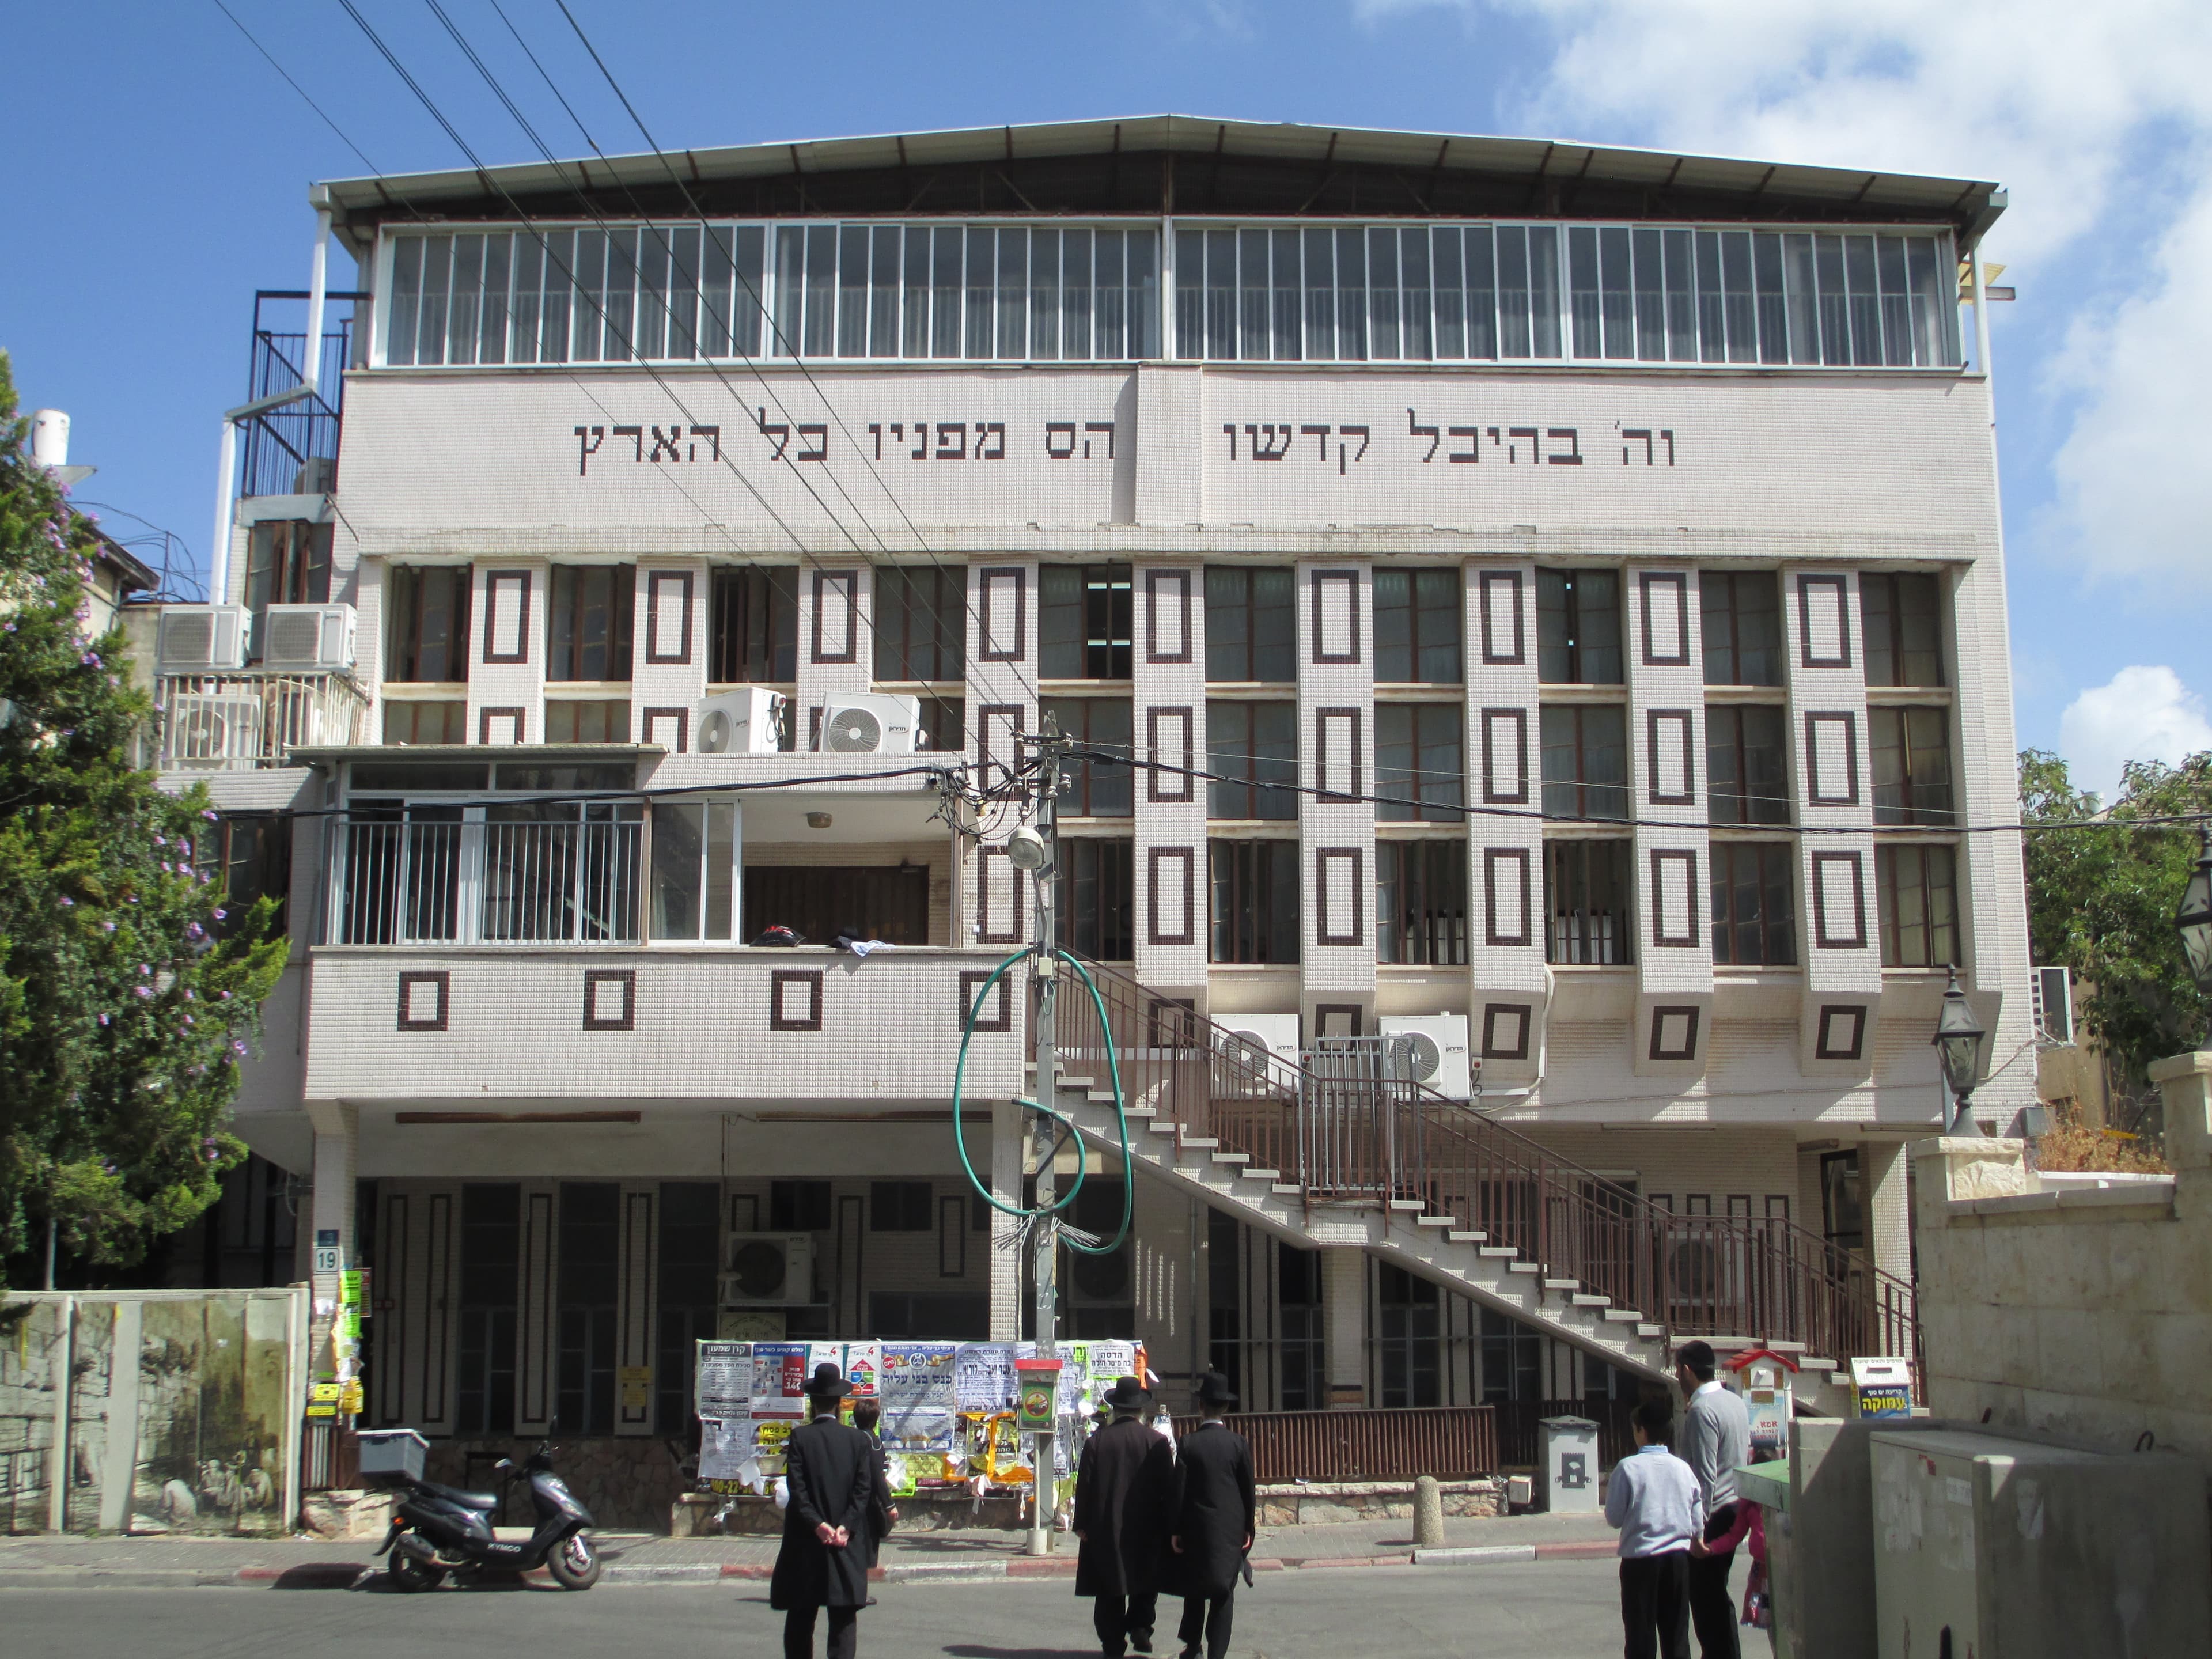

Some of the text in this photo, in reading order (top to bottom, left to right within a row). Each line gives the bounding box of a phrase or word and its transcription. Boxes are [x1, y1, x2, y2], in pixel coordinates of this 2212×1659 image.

[757, 407, 828, 461] כל
[868, 422, 1005, 460] מפניו
[1046, 422, 1115, 460] הס
[1408, 408, 1583, 466] בהיכל
[574, 420, 721, 476] הארץ
[1223, 425, 1370, 476] קדשו
[318, 1251, 336, 1268] 19
[707, 1345, 745, 1355] קרן שמעון
[830, 1346, 837, 1355] 4
[868, 1346, 874, 1355] 4
[882, 1370, 952, 1385] כנס בני עליה
[999, 1364, 1012, 1375] אשר
[487, 1543, 521, 1553] KYMCO
